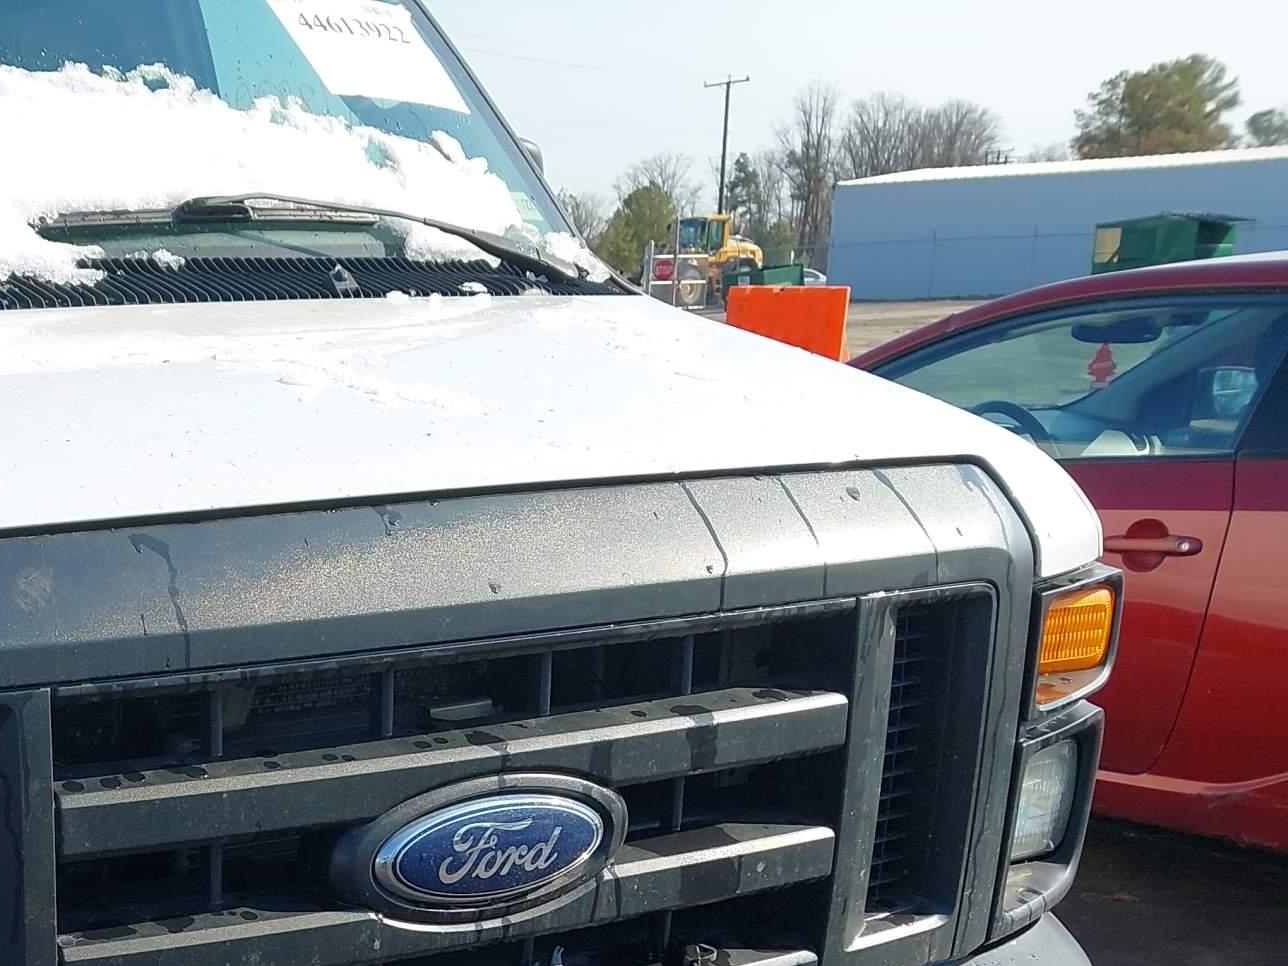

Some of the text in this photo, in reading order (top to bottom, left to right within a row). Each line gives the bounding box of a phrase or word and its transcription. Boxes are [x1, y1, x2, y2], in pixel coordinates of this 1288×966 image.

[298, 12, 411, 44] 44613922
[655, 265, 673, 275] STOP
[439, 818, 562, 885] Ford
